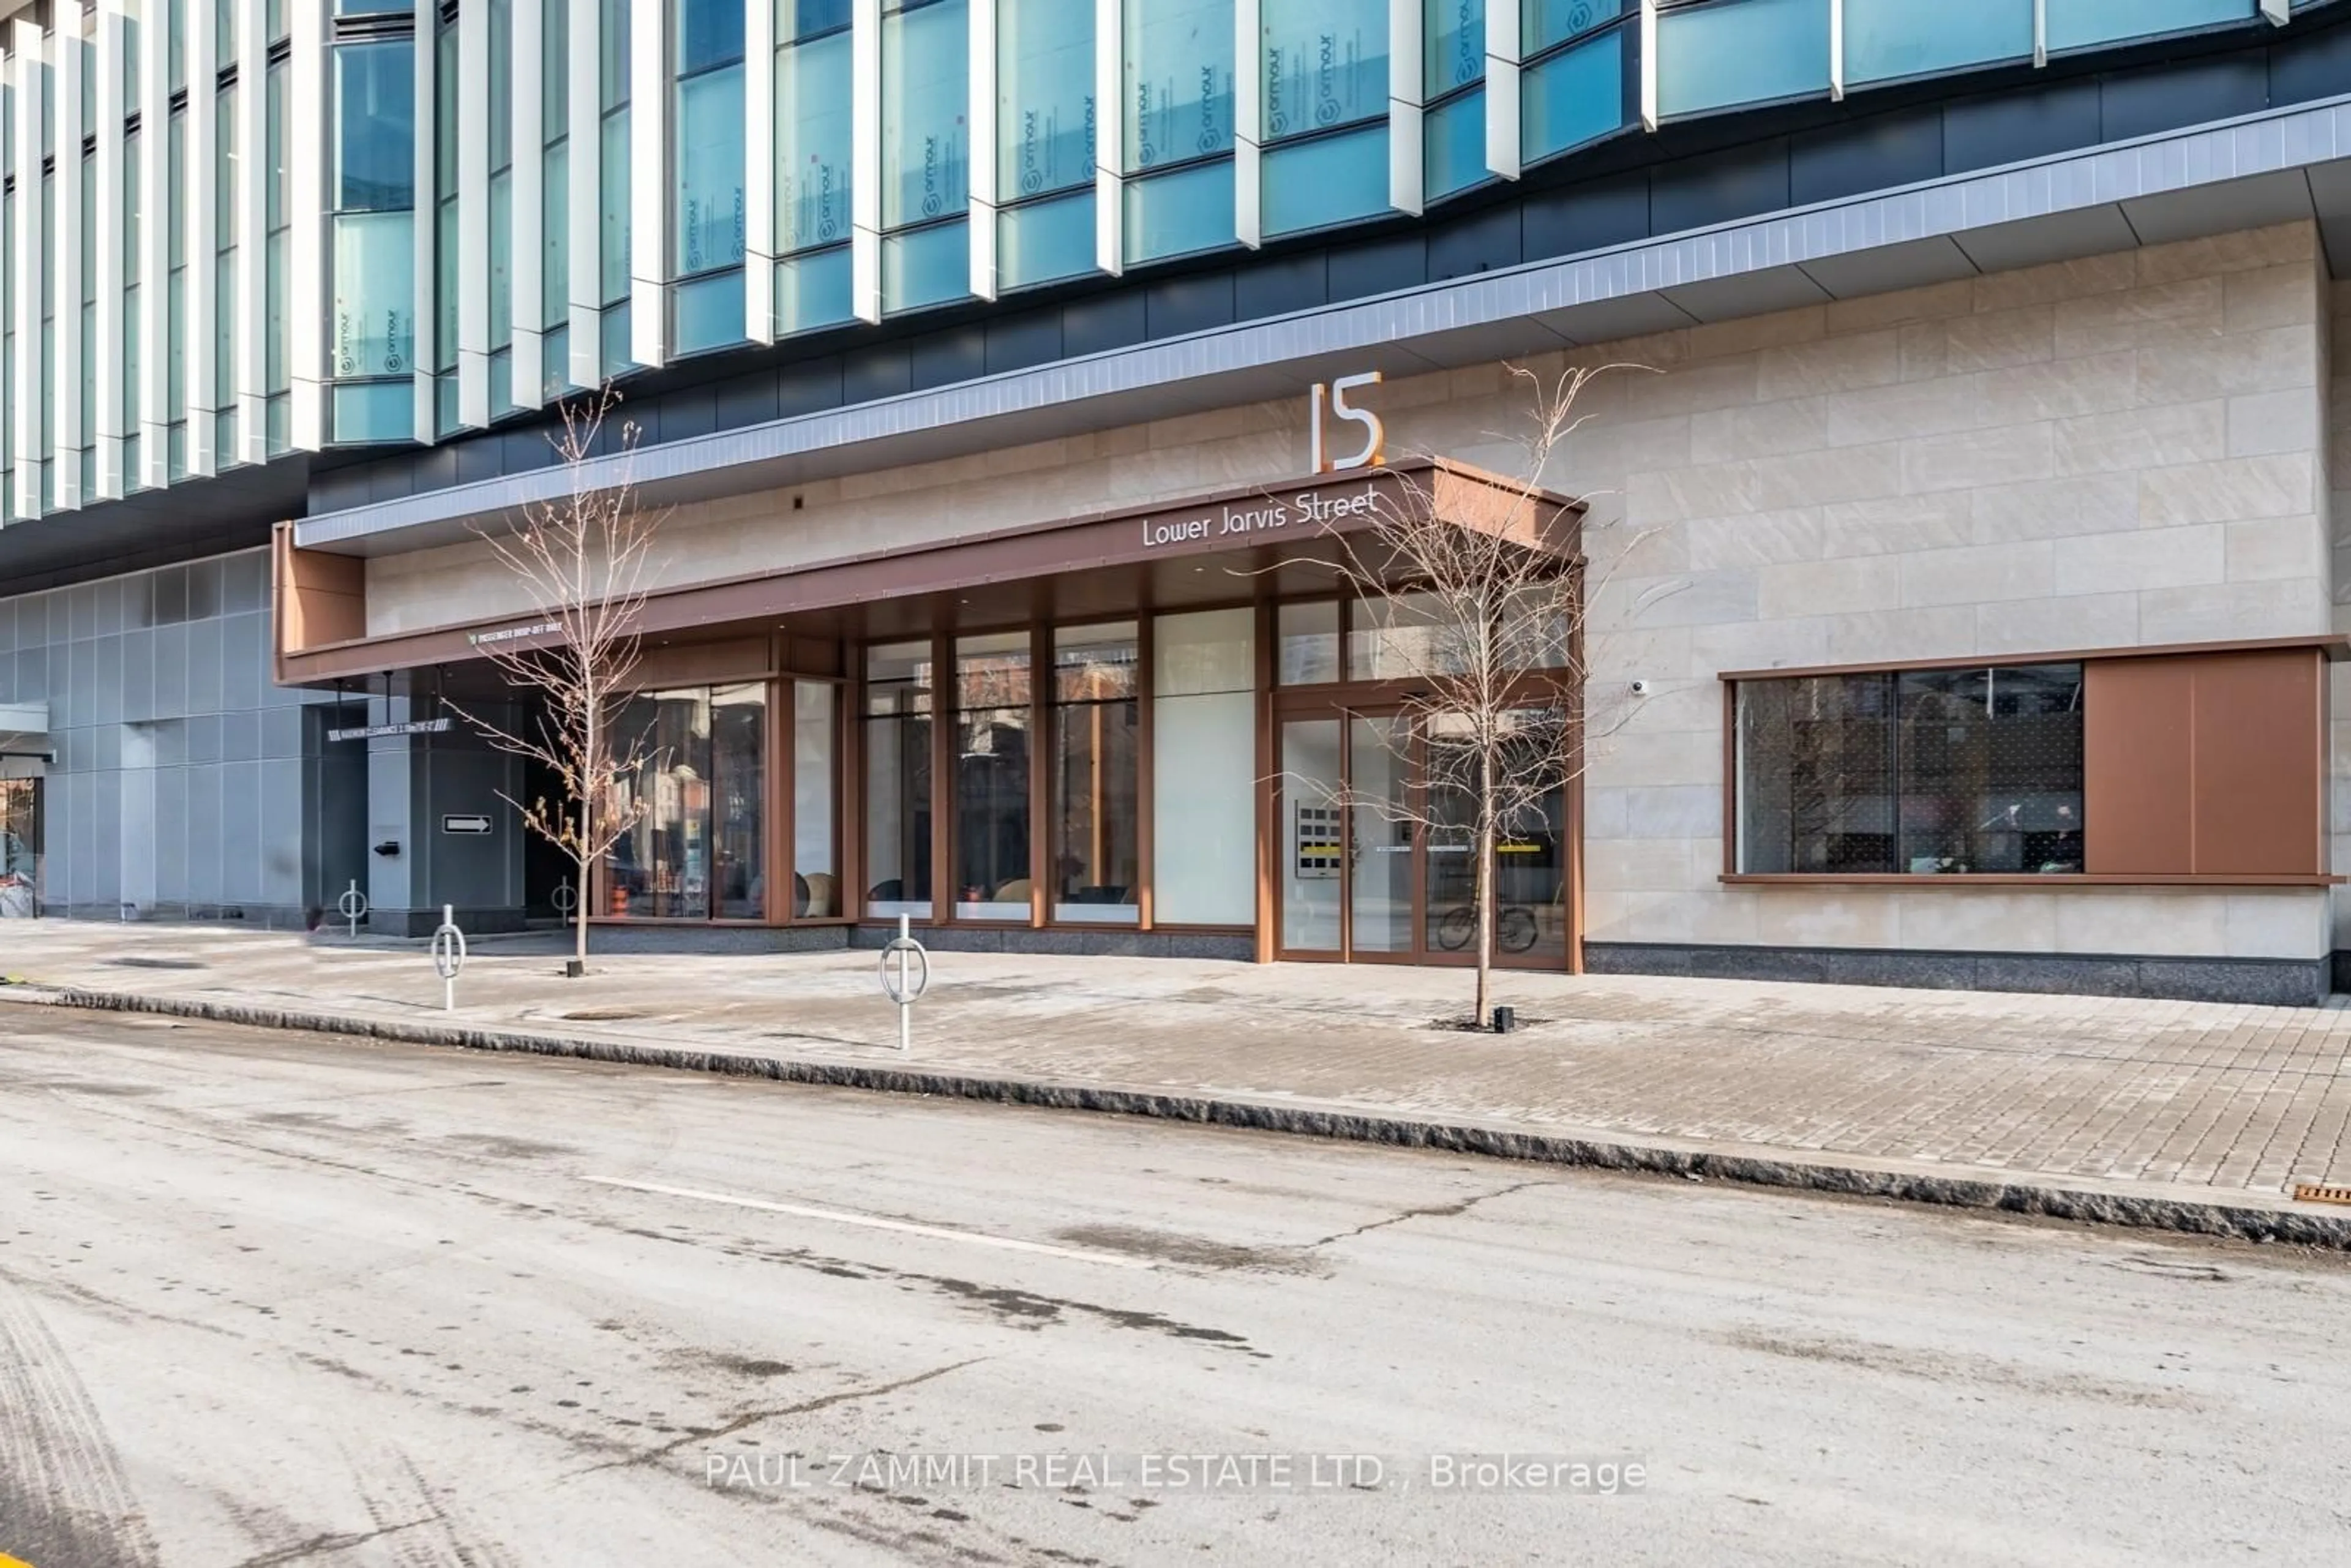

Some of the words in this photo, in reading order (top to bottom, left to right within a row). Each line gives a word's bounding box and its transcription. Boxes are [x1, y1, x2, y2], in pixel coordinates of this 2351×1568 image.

[1202, 66, 1212, 128] armour
[1269, 47, 1280, 111] armour
[1321, 34, 1332, 97] armour
[925, 137, 936, 193] armour
[1025, 110, 1036, 168] armour
[1311, 372, 1385, 474] 15
[1143, 519, 1212, 547] Lower
[1220, 506, 1286, 535] Jarvis
[1295, 483, 1380, 523] Street
